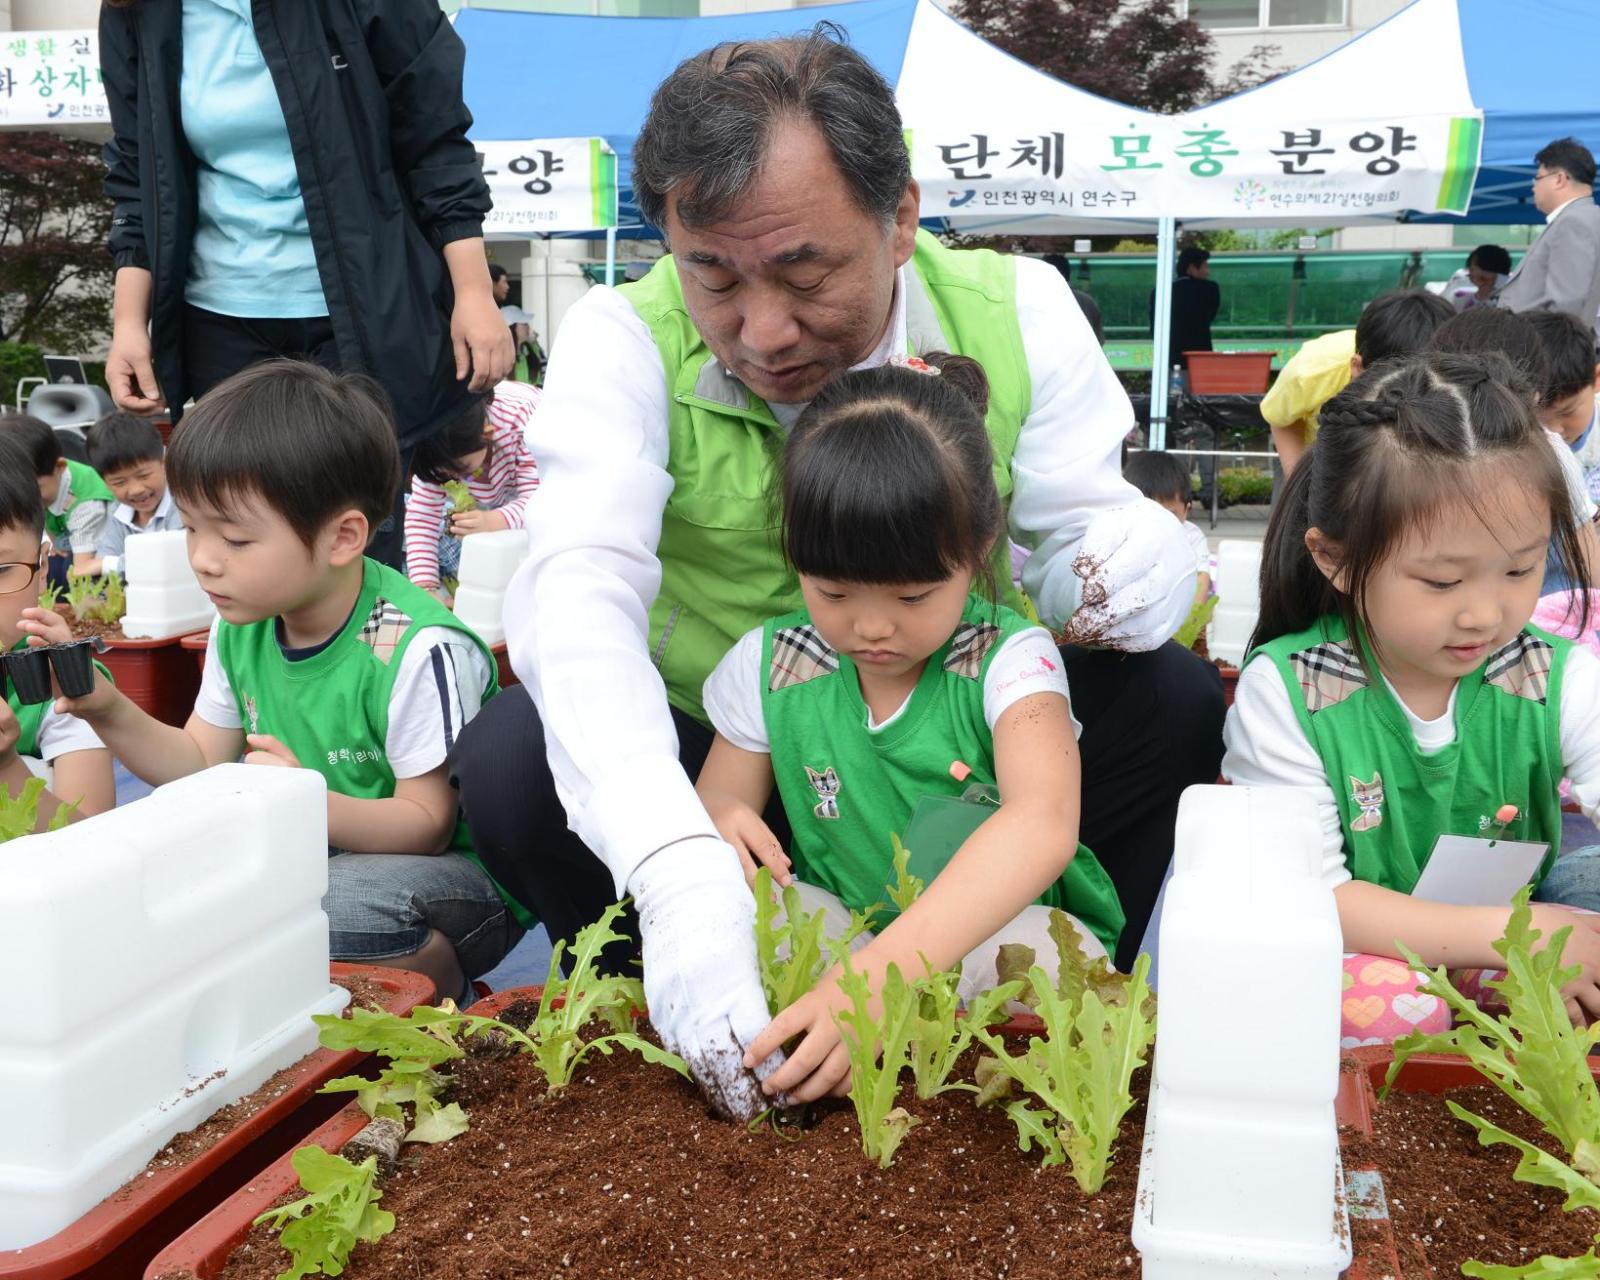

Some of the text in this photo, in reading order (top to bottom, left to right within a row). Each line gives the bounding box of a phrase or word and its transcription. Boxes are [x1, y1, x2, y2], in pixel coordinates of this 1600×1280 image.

[30, 64, 104, 97] 상자
[476, 149, 564, 195] 양
[936, 126, 1417, 180] 단체 모종 분양
[983, 189, 1137, 207] 인천광역시 연수구
